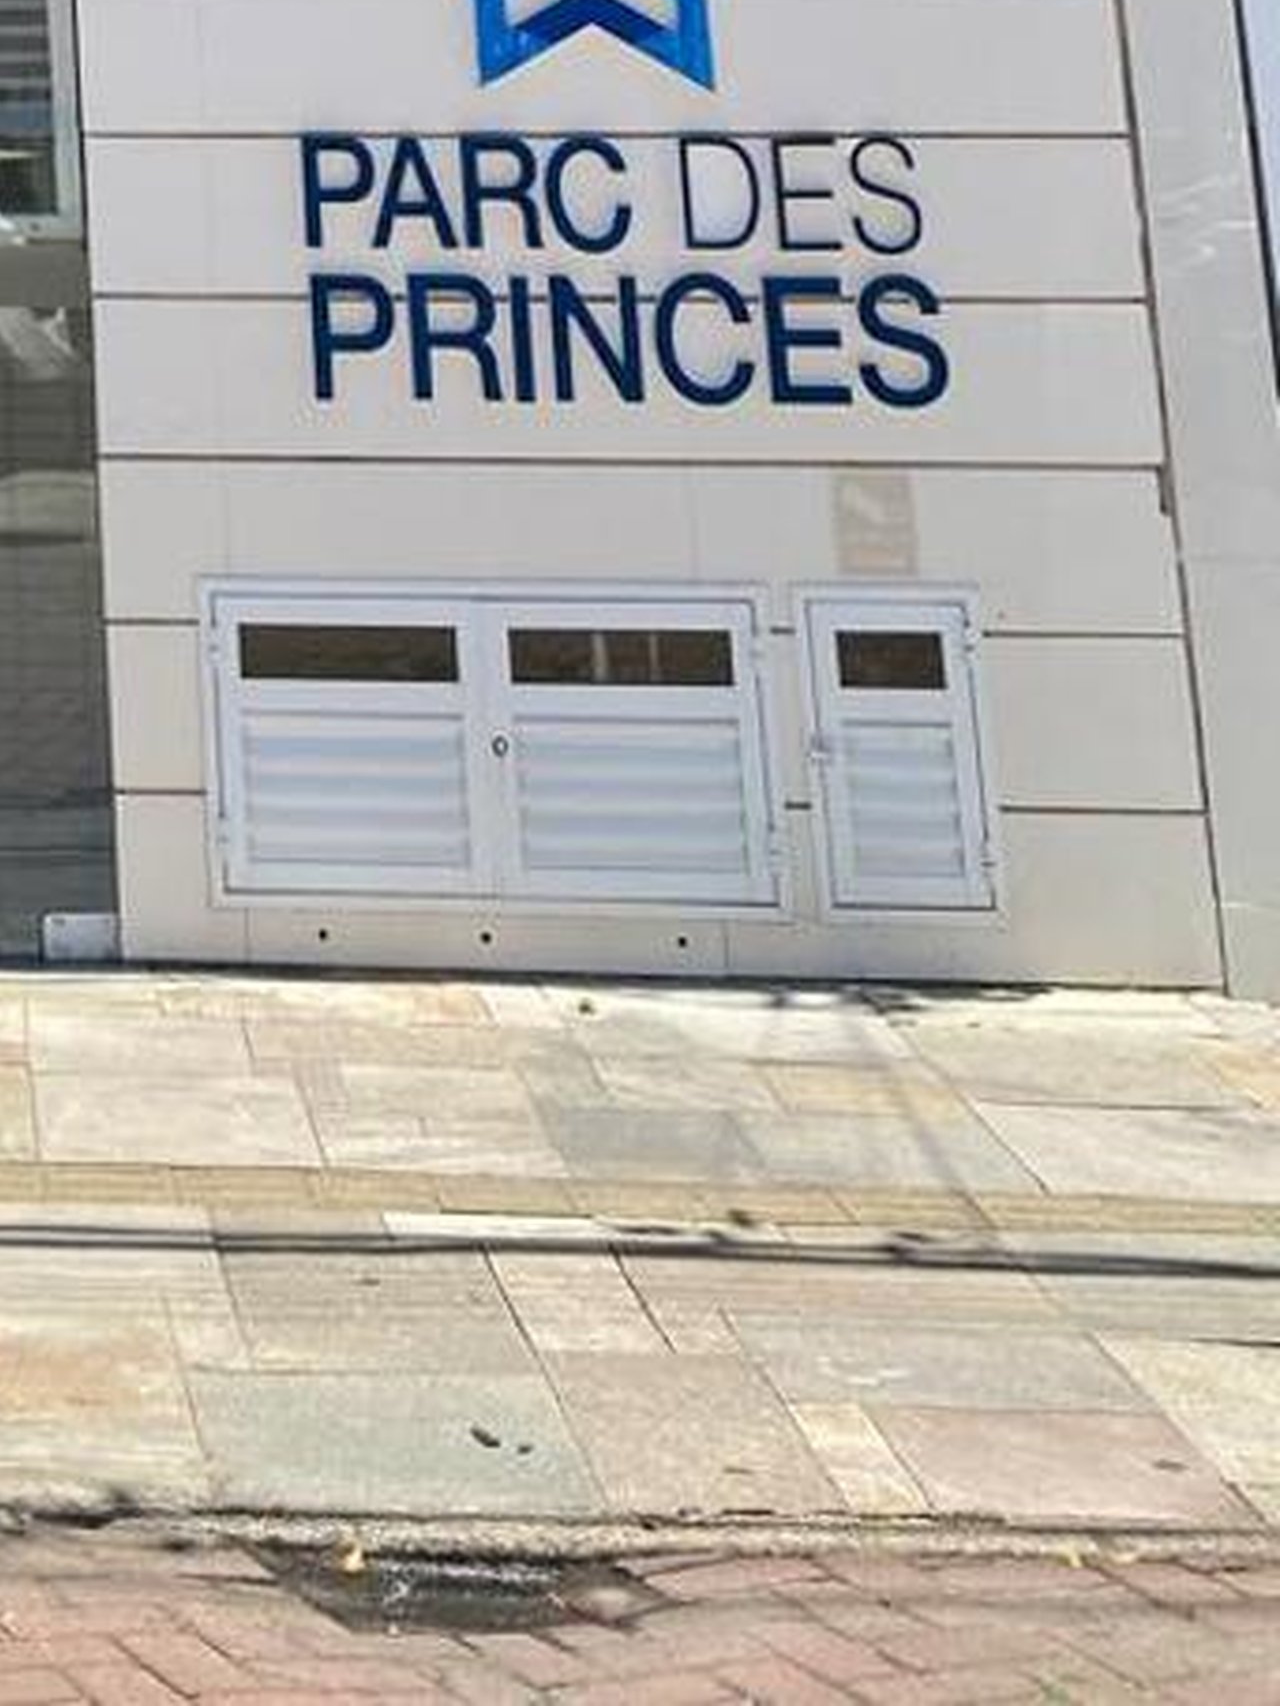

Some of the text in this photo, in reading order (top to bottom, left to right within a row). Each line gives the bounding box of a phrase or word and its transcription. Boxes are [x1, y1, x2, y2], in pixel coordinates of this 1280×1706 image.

[300, 134, 923, 254] PARC DES
[309, 273, 949, 406] PRINCES
